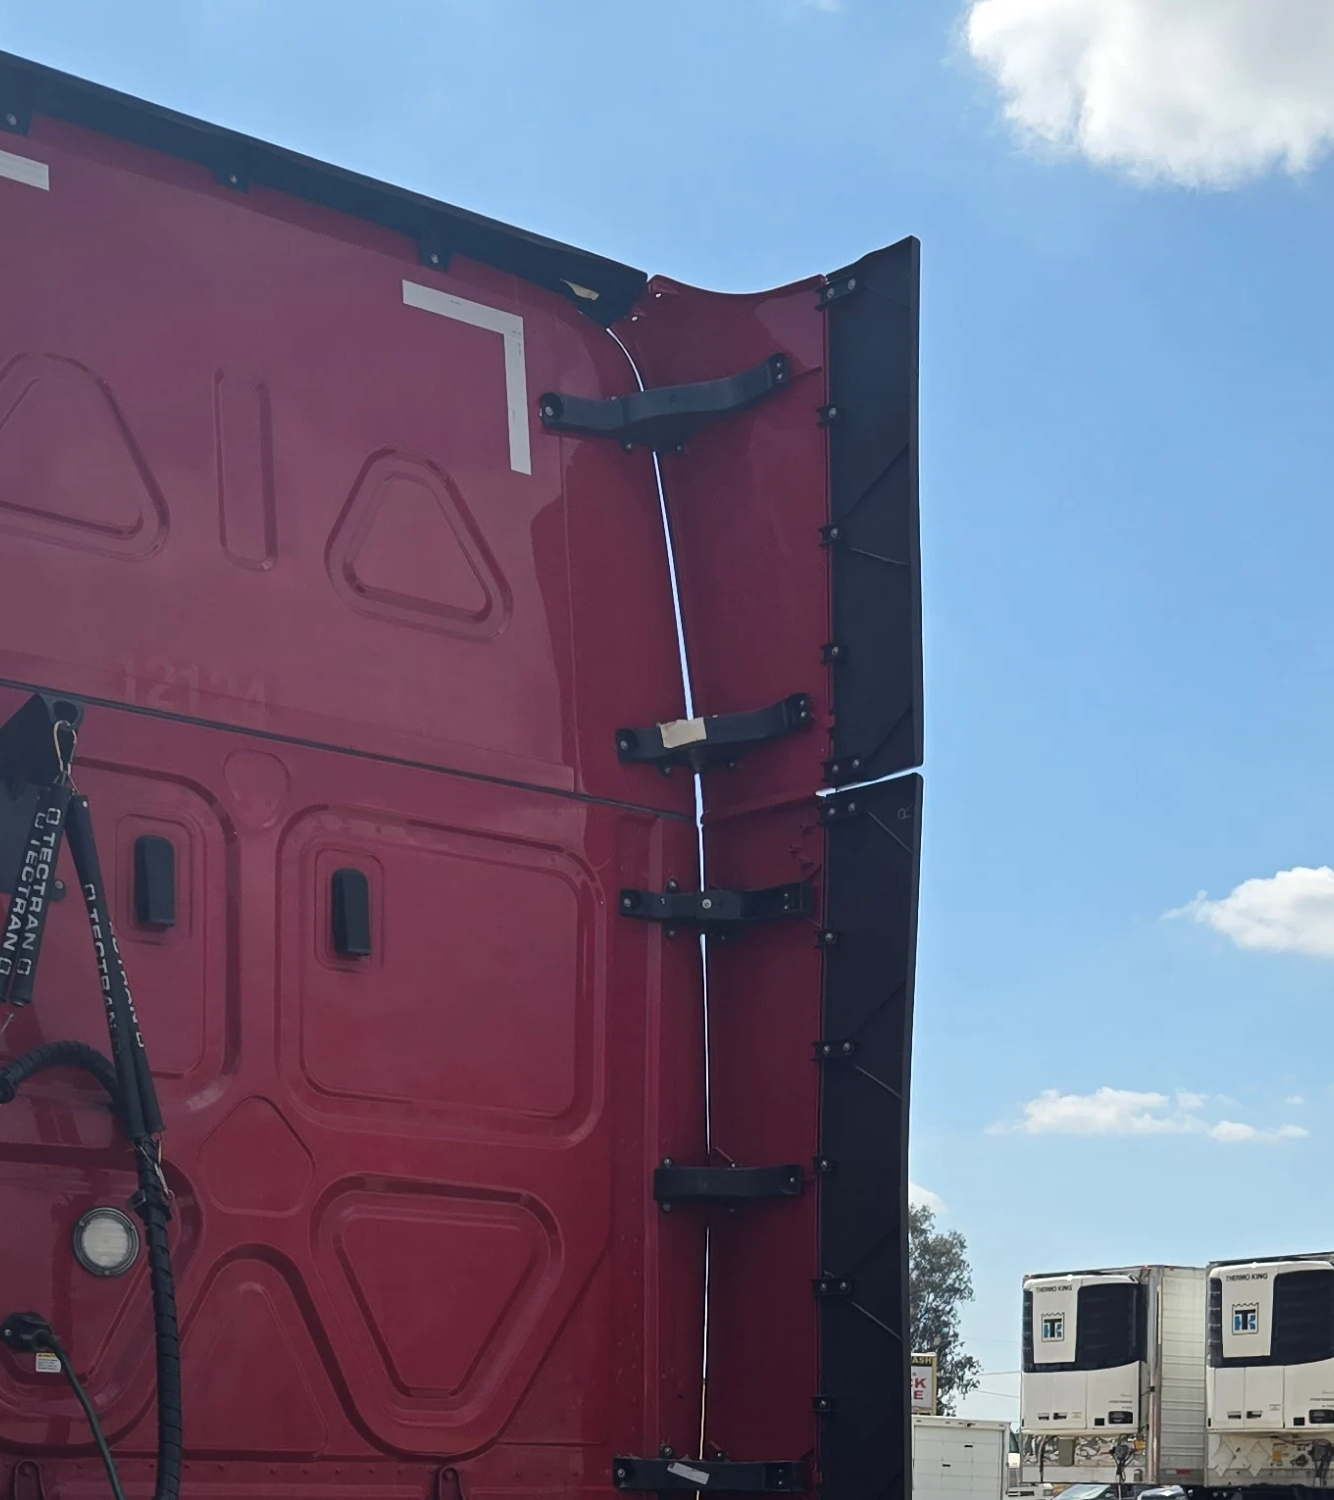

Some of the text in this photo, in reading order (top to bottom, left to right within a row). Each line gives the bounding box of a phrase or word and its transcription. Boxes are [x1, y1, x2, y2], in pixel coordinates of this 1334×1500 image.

[21, 831, 57, 952] TECTRAN
[1225, 1273, 1269, 1282] THERMO KING
[1036, 1284, 1073, 1293] THERMO KING
[911, 1356, 932, 1366] ASH
